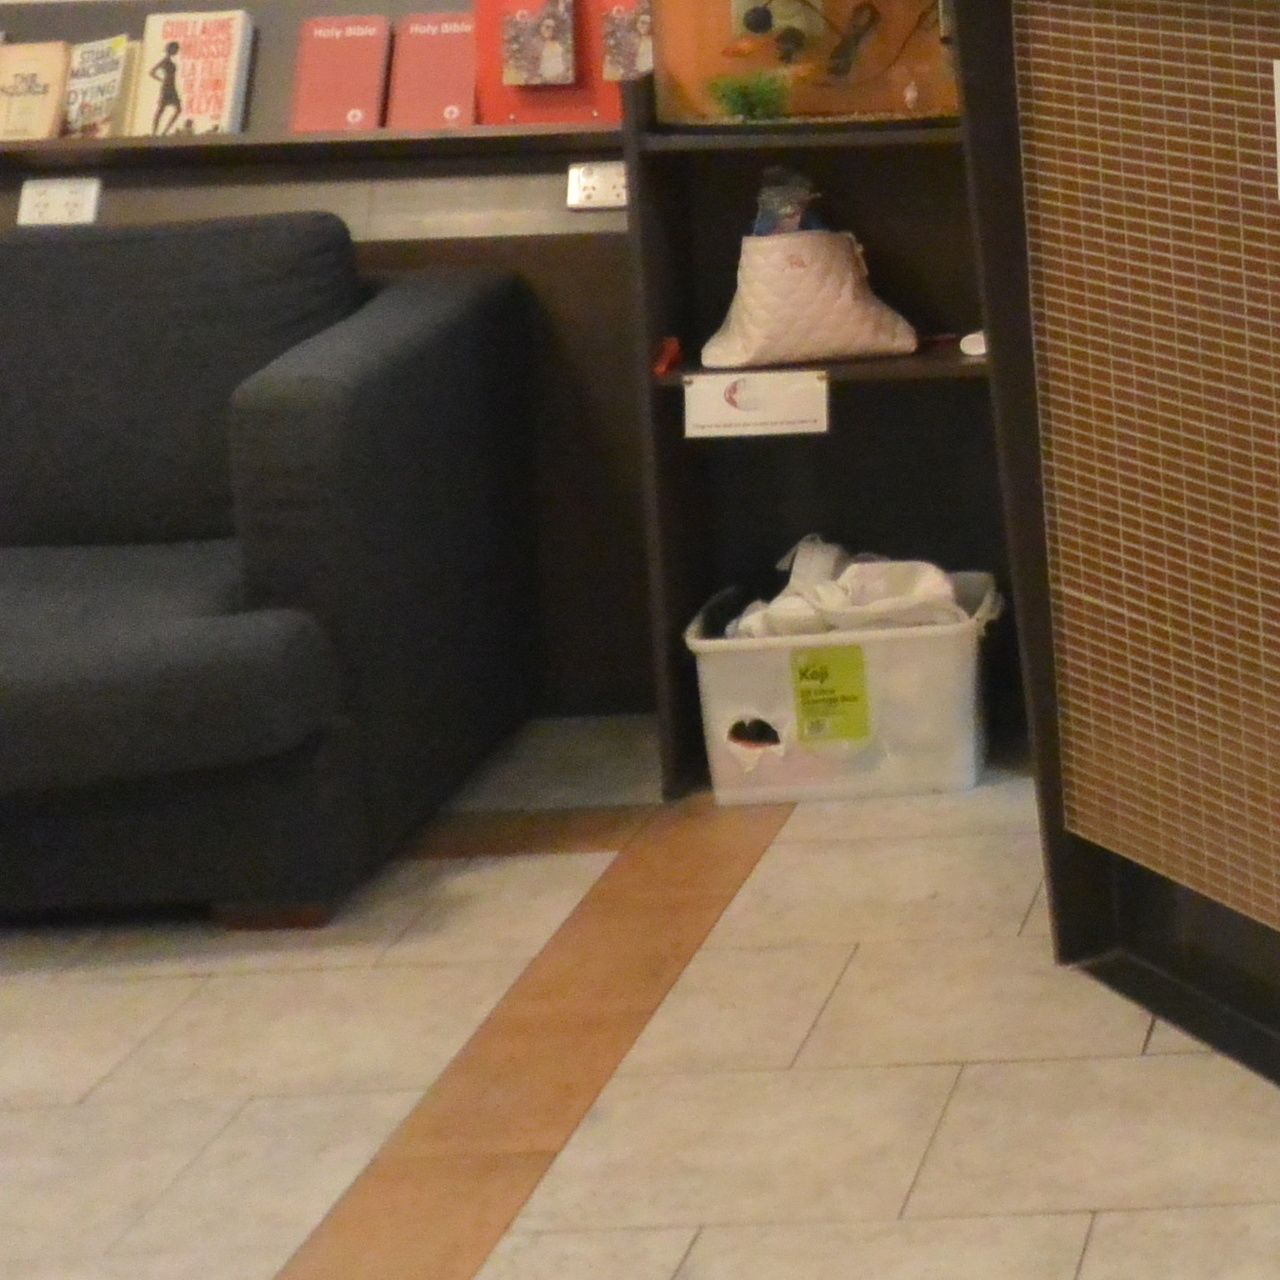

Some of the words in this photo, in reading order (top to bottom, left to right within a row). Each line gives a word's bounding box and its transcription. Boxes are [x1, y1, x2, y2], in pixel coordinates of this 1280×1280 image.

[314, 27, 342, 39] Holy
[345, 25, 377, 37] Bible
[409, 23, 438, 35] Holy
[441, 22, 473, 34] Bible
